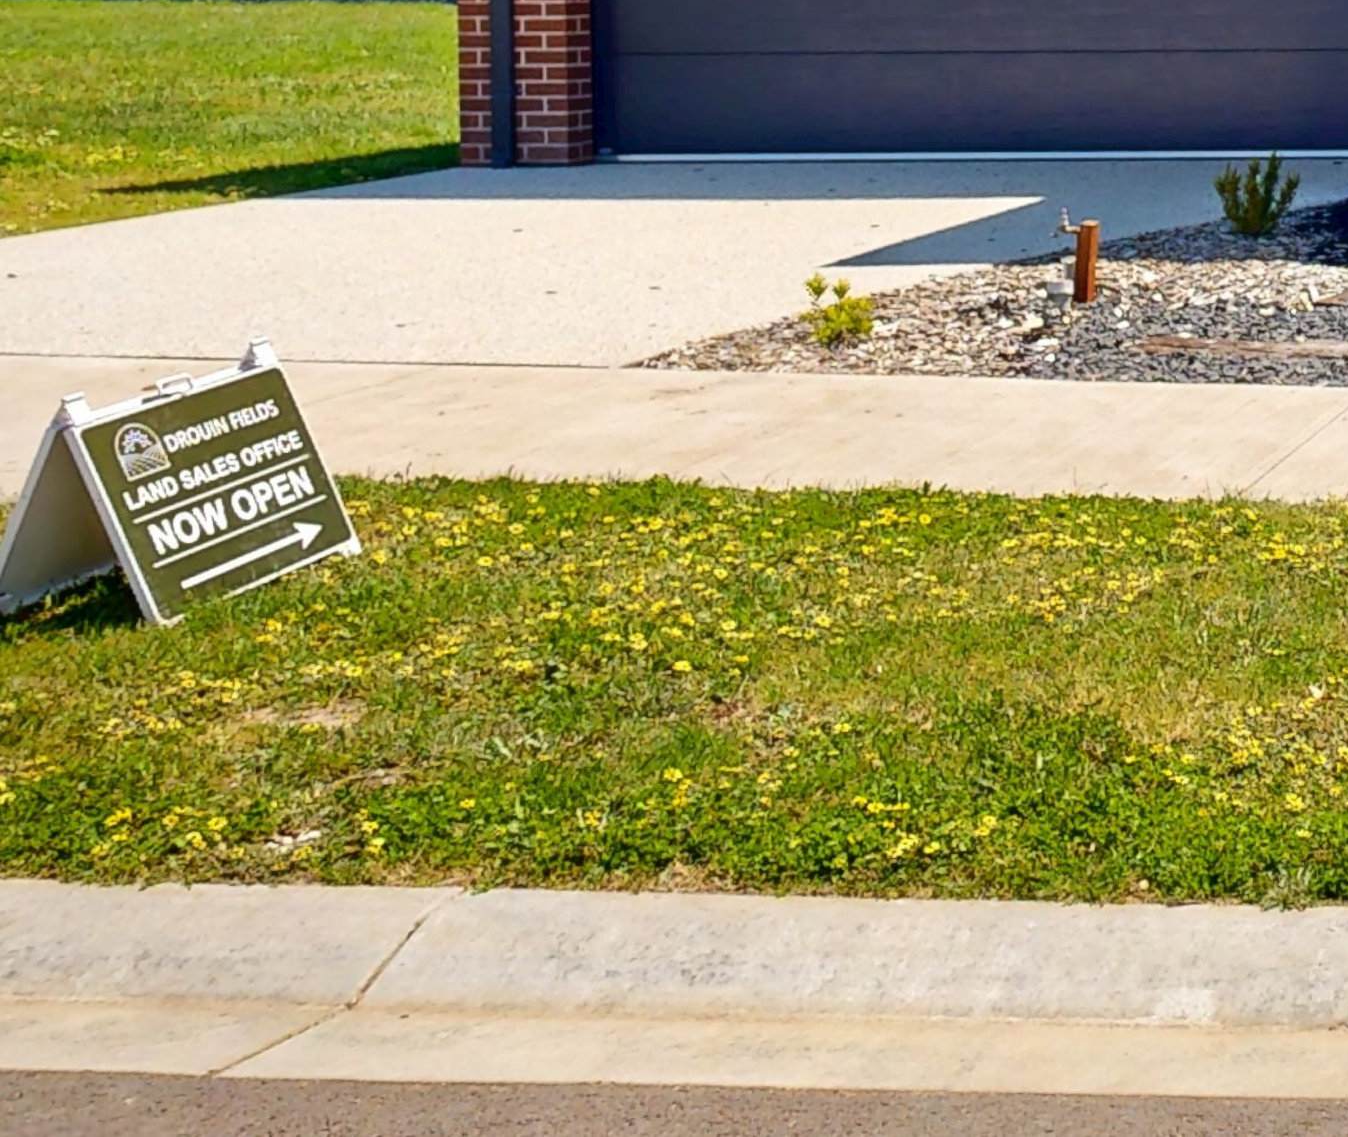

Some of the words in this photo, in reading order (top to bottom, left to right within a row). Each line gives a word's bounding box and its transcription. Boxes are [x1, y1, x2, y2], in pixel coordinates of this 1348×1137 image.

[163, 415, 230, 453] DROUIN
[228, 399, 280, 430] FIELDS
[122, 476, 179, 511] LAND
[178, 453, 241, 490] SALES
[239, 430, 304, 467] OFFICE
[147, 497, 229, 555] NOW
[230, 465, 316, 521] OPEN
